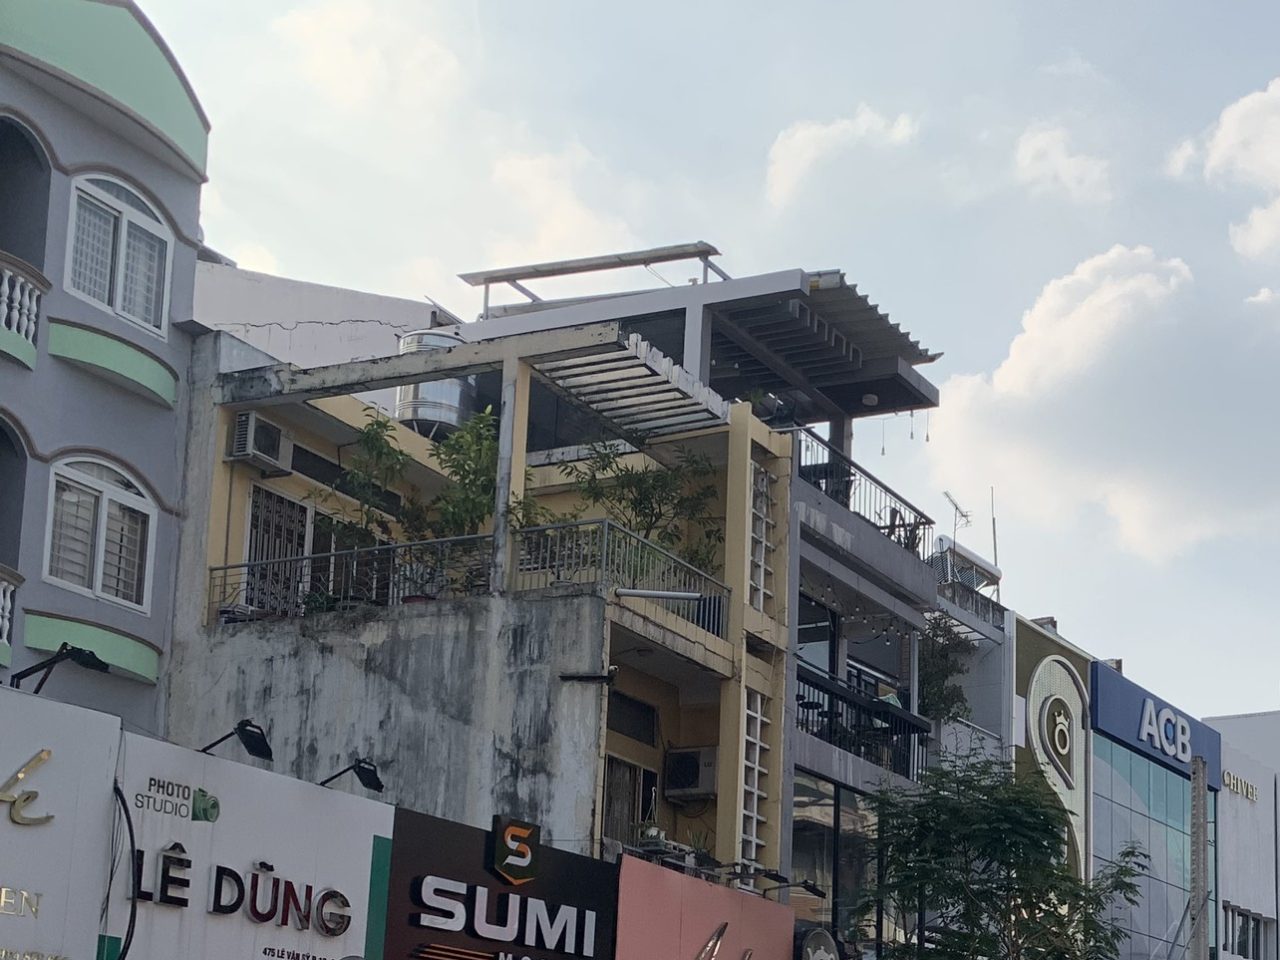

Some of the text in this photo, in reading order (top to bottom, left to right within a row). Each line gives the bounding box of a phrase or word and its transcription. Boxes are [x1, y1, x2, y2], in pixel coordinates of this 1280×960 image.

[1139, 698, 1192, 764] ACB
[135, 794, 190, 818] STUDIO
[148, 777, 191, 800] PHOTO
[128, 843, 352, 937] LÊ DŨNG
[419, 875, 597, 957] SUMI
[262, 947, 275, 957] 475
[277, 948, 285, 959] LÊ
